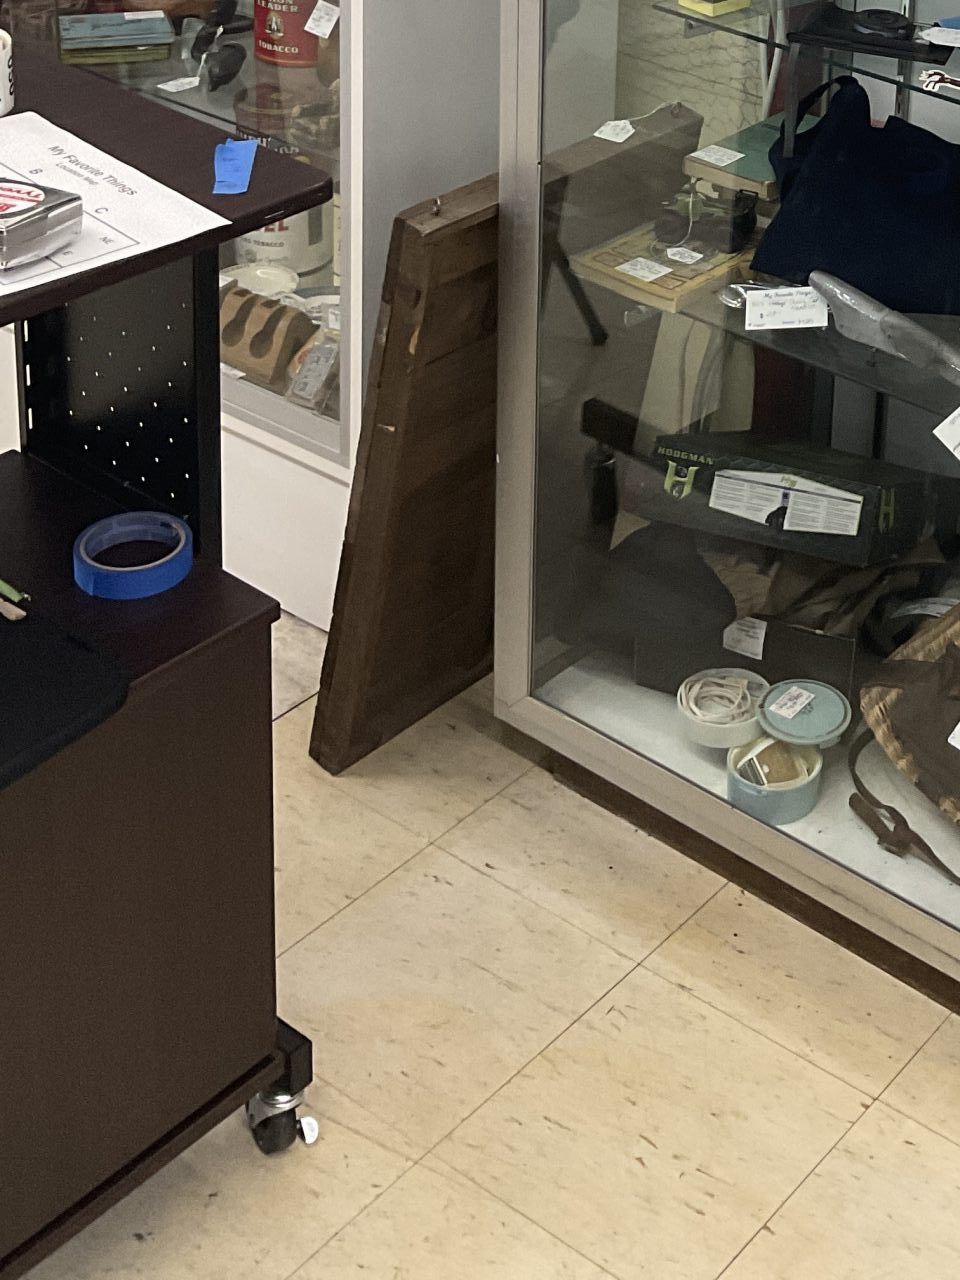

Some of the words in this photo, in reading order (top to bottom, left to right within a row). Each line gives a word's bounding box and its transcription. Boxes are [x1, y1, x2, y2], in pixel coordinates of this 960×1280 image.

[257, 0, 299, 13] LEADER
[258, 39, 299, 54] TOBACCO
[48, 145, 67, 157] My
[63, 154, 105, 177] Favorite
[102, 174, 138, 197] Things
[94, 207, 109, 215] C
[656, 446, 714, 466] HODGMAN
